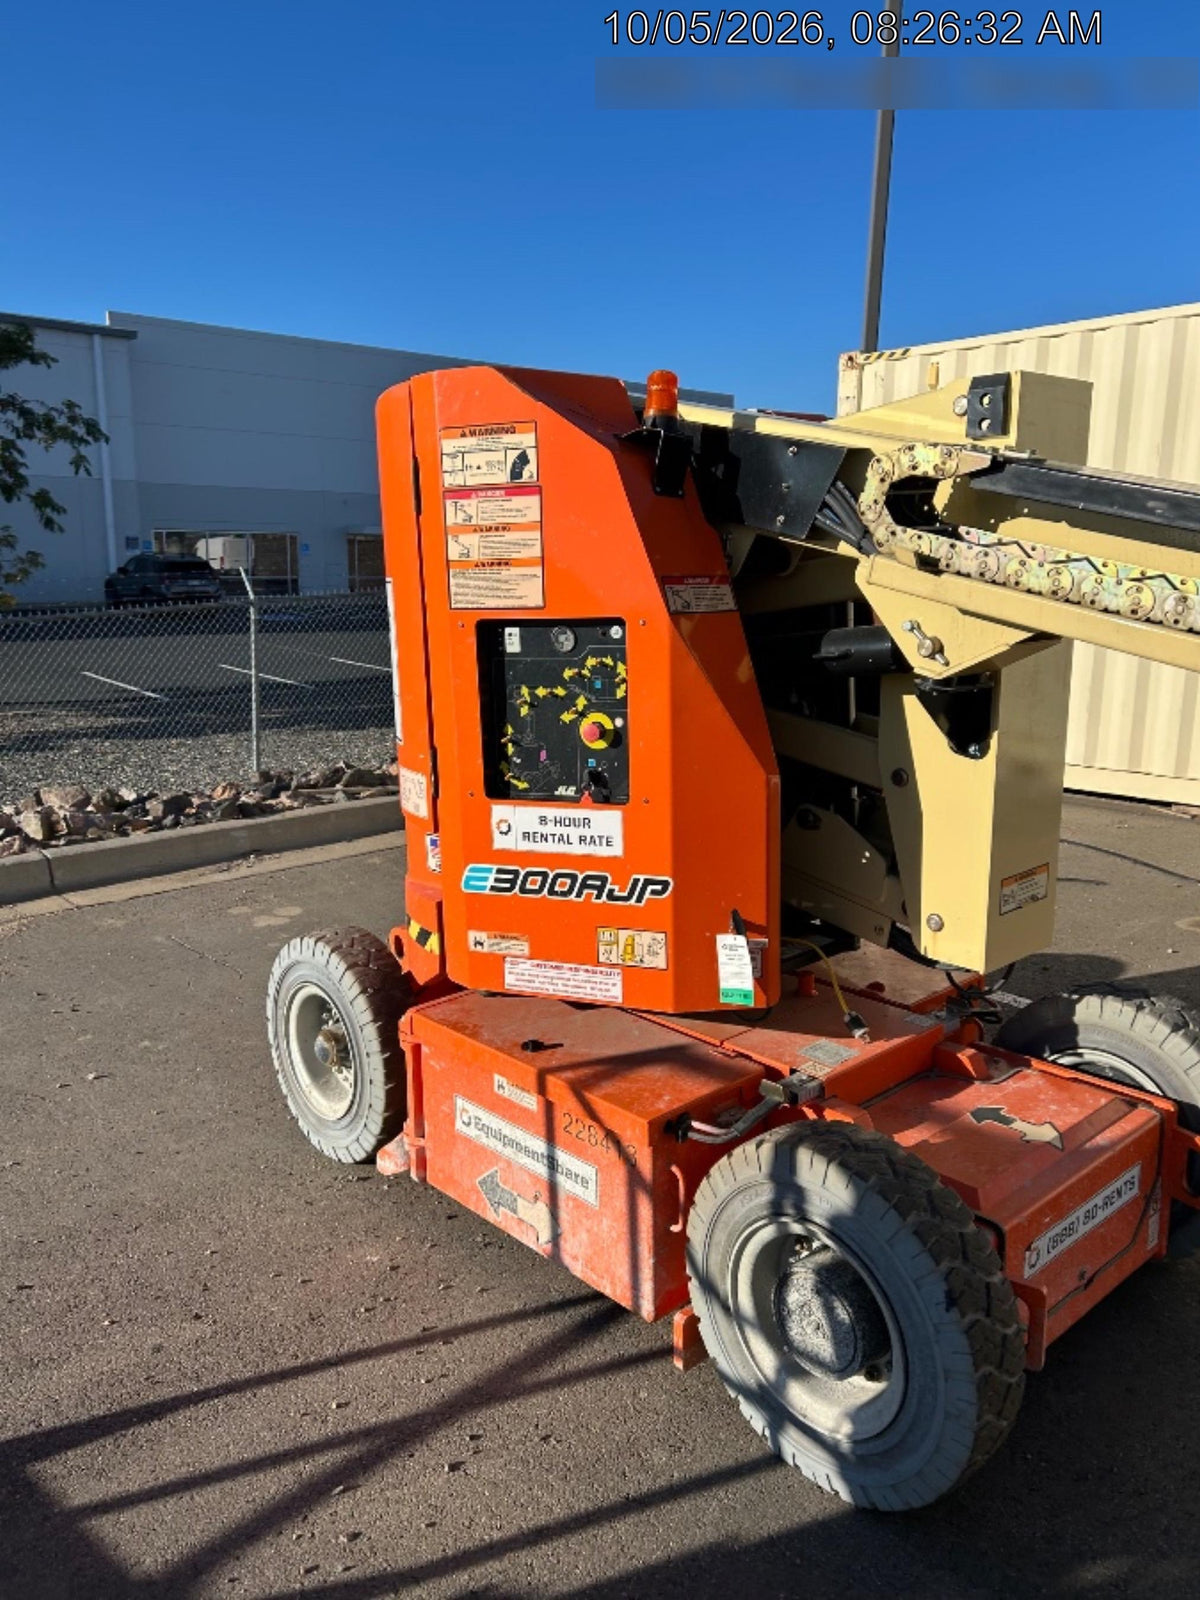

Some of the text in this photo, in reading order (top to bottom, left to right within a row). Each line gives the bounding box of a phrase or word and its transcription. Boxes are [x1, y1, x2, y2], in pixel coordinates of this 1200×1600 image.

[522, 831, 615, 848] RENTAL RATE
[538, 815, 592, 830] 8-HOUR
[462, 864, 673, 906] E300AJP
[474, 1116, 590, 1190] EquipmentShare
[1046, 1216, 1080, 1255] (888)
[1082, 1175, 1136, 1227] 80-RENTS
